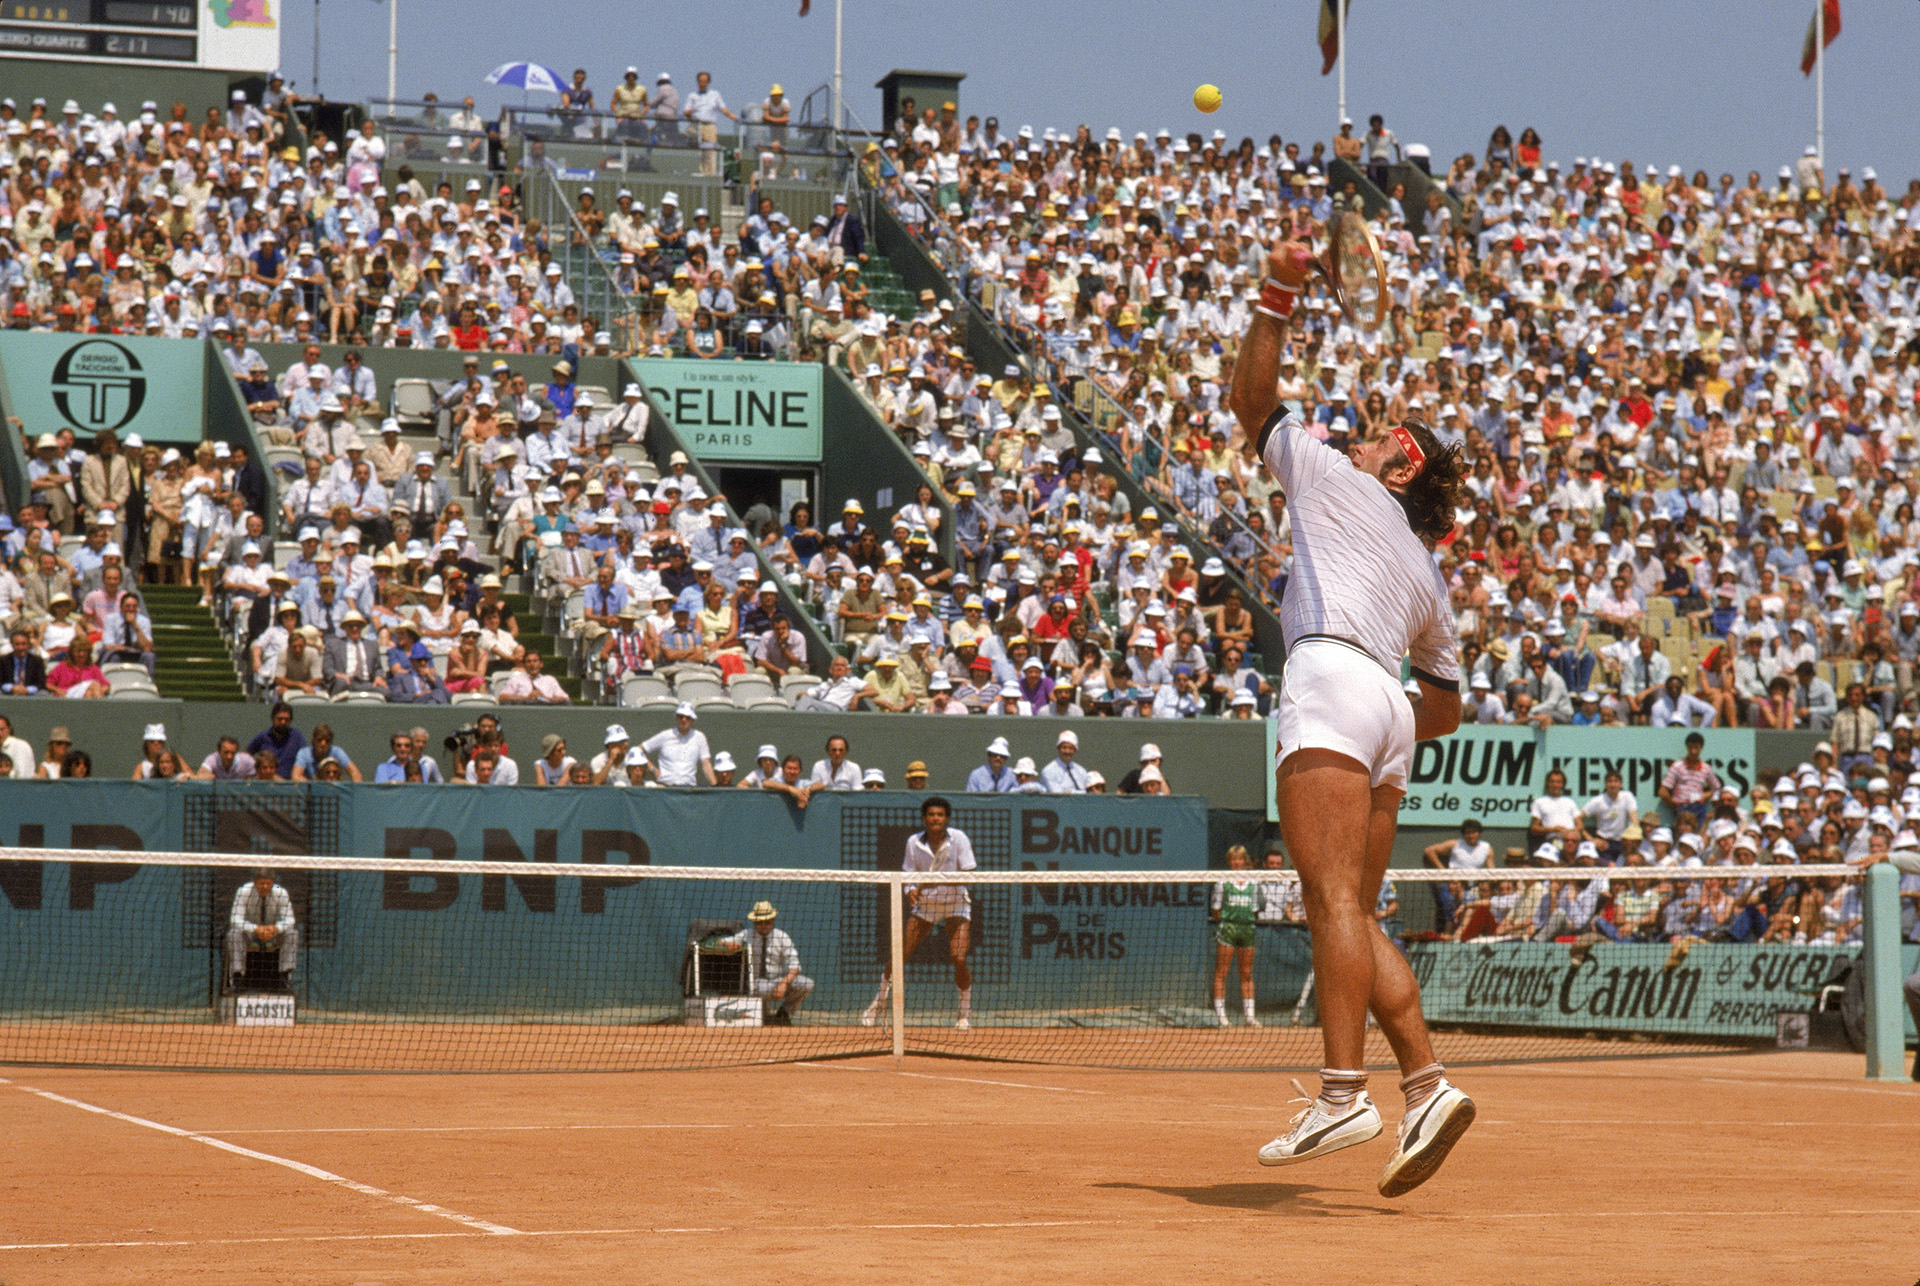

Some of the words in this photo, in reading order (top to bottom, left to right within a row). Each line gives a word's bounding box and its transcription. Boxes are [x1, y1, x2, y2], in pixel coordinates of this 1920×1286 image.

[75, 363, 125, 373] TACCHINI
[81, 354, 118, 363] SERGIO
[695, 433, 753, 447] PARIS
[1410, 739, 1538, 786] DIUM
[1432, 793, 1460, 811] de
[1021, 809, 1163, 858] BANQUE
[382, 827, 650, 914] BNP
[1021, 861, 1205, 907] NATIONALE
[1077, 914, 1105, 927] DE
[1021, 912, 1126, 961] PARIS
[1559, 953, 1703, 1019] Canon
[239, 1003, 294, 1018] LACOSTE
[1705, 1001, 1808, 1026] PERFOR
